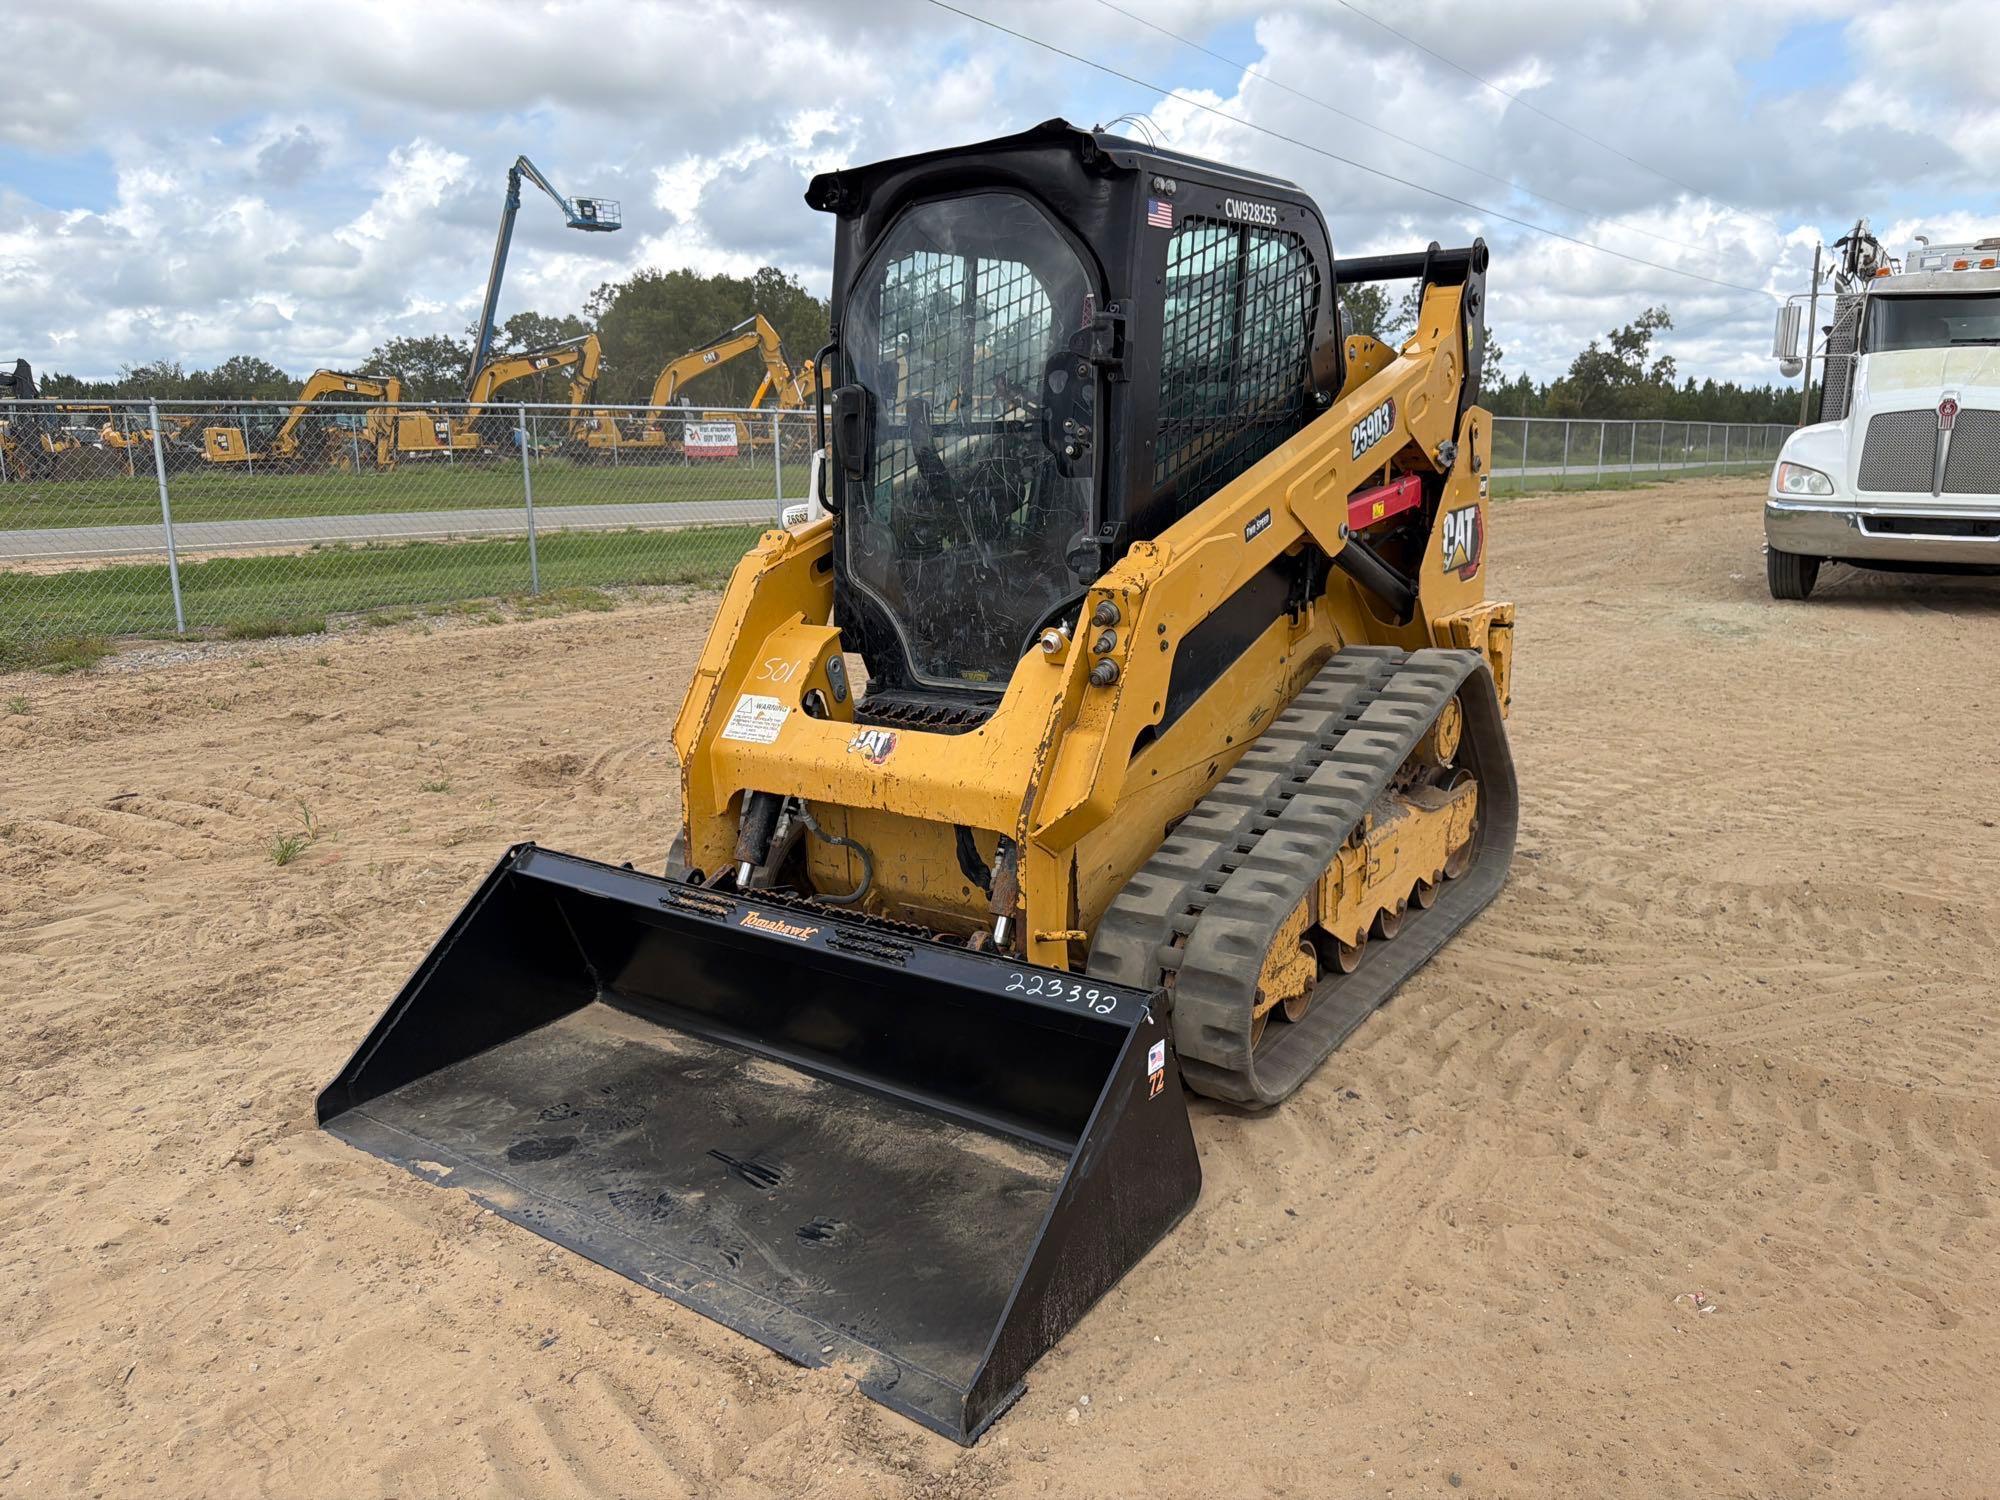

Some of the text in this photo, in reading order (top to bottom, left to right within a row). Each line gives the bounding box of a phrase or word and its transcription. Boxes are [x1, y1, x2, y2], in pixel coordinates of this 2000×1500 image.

[1225, 198, 1277, 226] CW928255
[535, 357, 549, 369] CAT
[704, 351, 716, 363] CAT
[435, 422, 449, 432] CAT
[1351, 402, 1390, 459] 259D3
[1443, 506, 1476, 573] CAT
[756, 702, 789, 713] WARNING
[739, 910, 819, 939] Tomahawk
[1004, 972, 1118, 1014] 223392
[1148, 1067, 1165, 1097] 72
